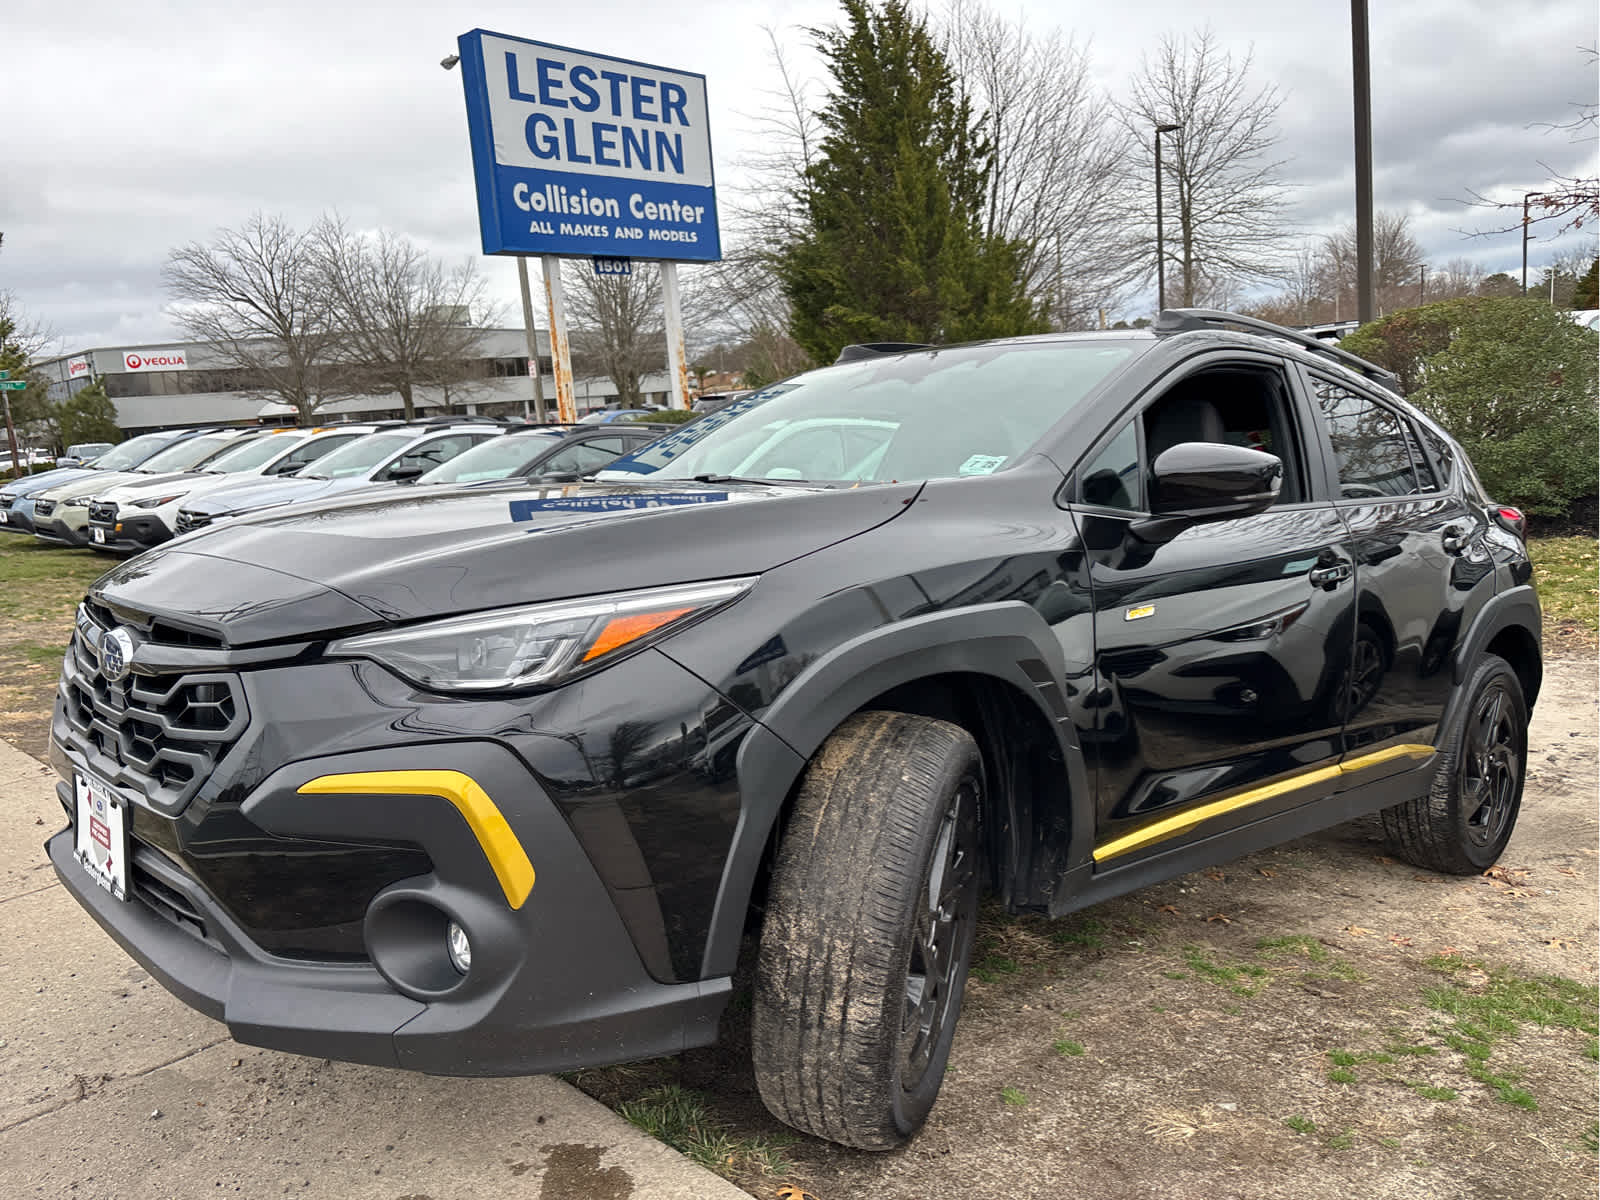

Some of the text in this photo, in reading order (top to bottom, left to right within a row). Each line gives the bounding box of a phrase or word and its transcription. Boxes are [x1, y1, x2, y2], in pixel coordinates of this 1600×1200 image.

[504, 51, 691, 127] LESTER
[524, 112, 685, 175] GLENN
[513, 182, 705, 224] Collision Center
[529, 220, 698, 243] ALL MAKES AND MODELS
[597, 260, 630, 273] 1501
[143, 356, 185, 366] VEOLIA
